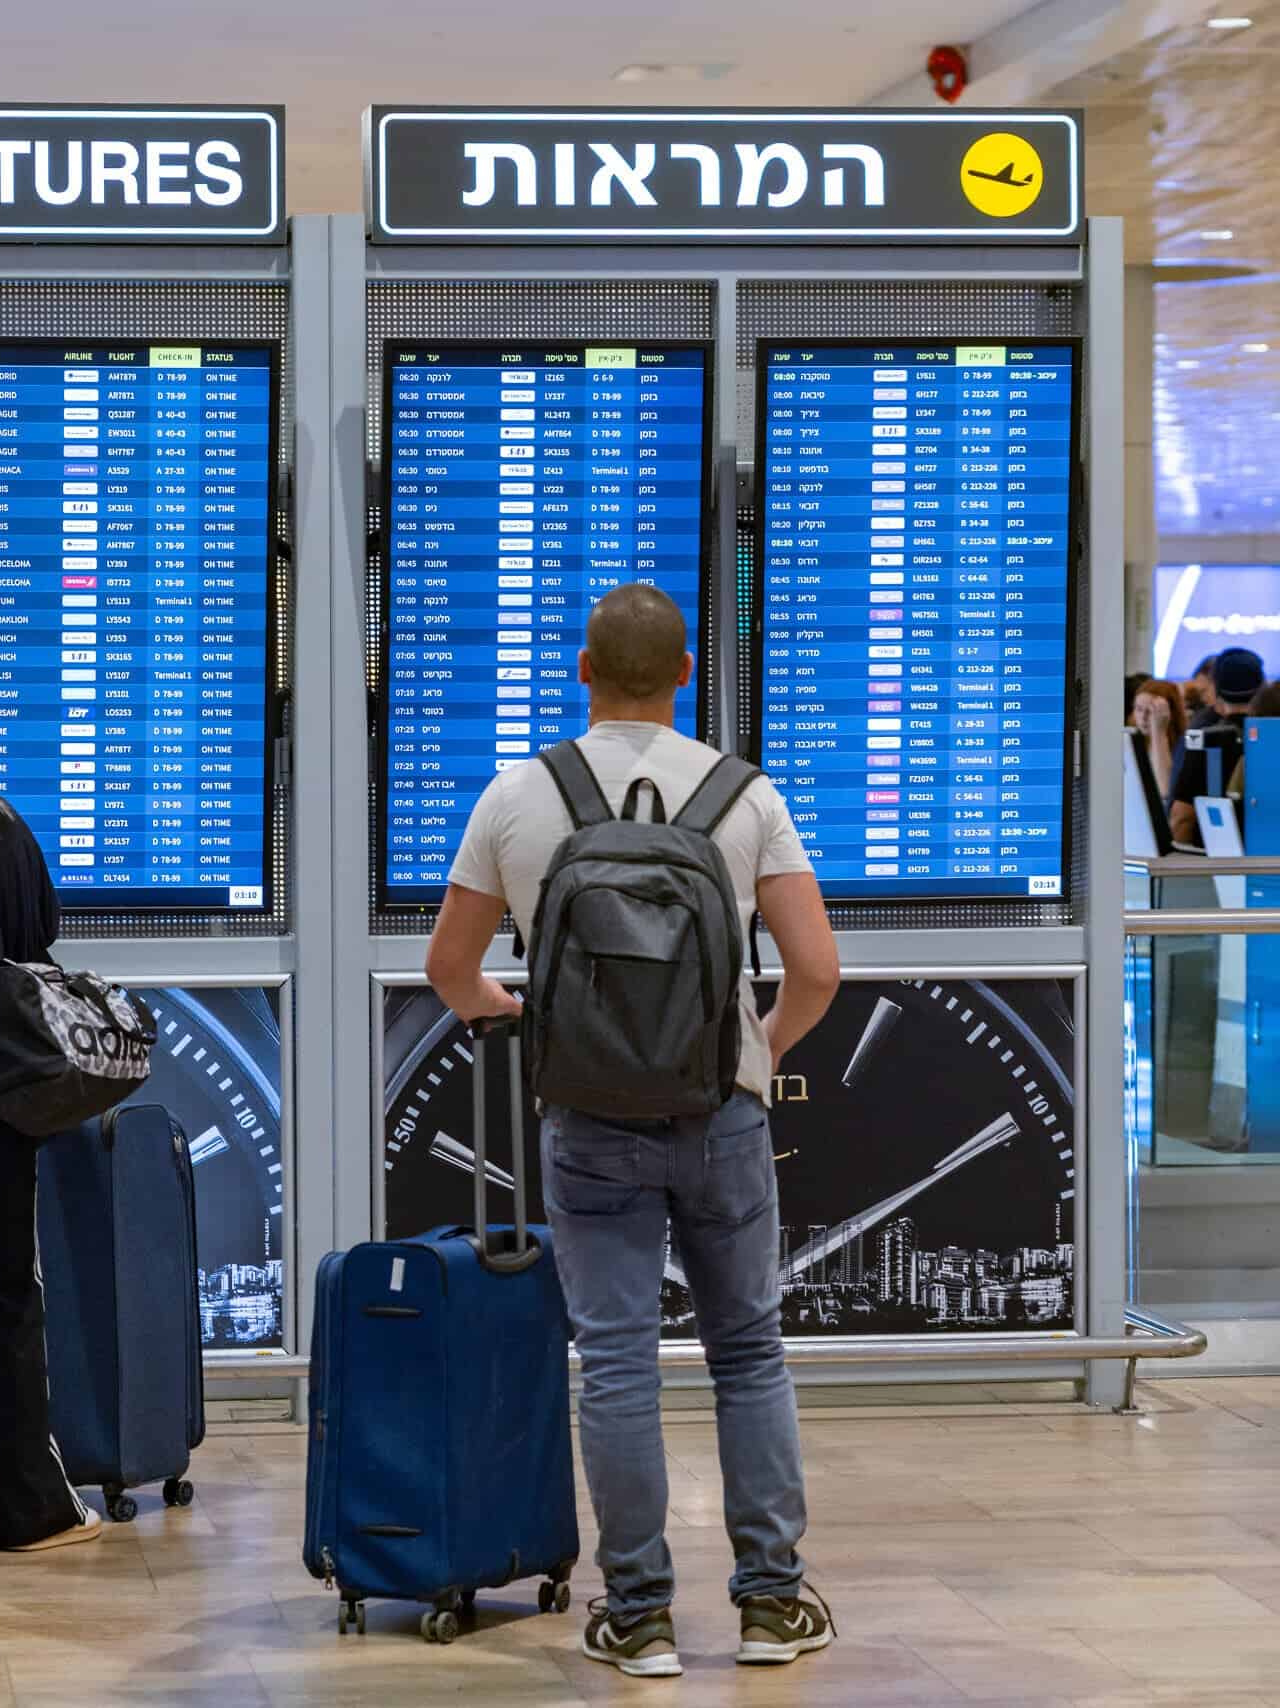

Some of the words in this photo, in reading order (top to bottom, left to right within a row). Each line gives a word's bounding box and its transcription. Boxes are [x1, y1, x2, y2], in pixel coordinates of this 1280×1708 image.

[462, 141, 886, 208] המראות
[64, 351, 93, 361] AIRLINE
[108, 352, 135, 361] FLIGHT
[206, 353, 234, 362] STATUS
[205, 373, 218, 382] ON
[218, 373, 238, 382] TIME
[205, 392, 218, 401] ON
[218, 392, 237, 401] TIME
[205, 410, 218, 420] ON
[217, 410, 237, 420] TIME
[204, 467, 217, 476] ON
[217, 467, 237, 476] TIME
[204, 485, 217, 495] ON
[216, 485, 236, 495] TIME
[203, 559, 216, 569] ON
[215, 559, 235, 569] TIME
[202, 597, 215, 606] ON
[215, 597, 234, 606] TIME
[202, 634, 215, 643] ON
[215, 634, 234, 643] TIME
[201, 708, 214, 717] ON
[214, 708, 233, 717] TIME
[199, 855, 213, 864] ON
[212, 855, 231, 864] TIME
[1027, 1093, 1050, 1116] 10
[233, 1105, 257, 1129] 10
[393, 1117, 417, 1144] 50
